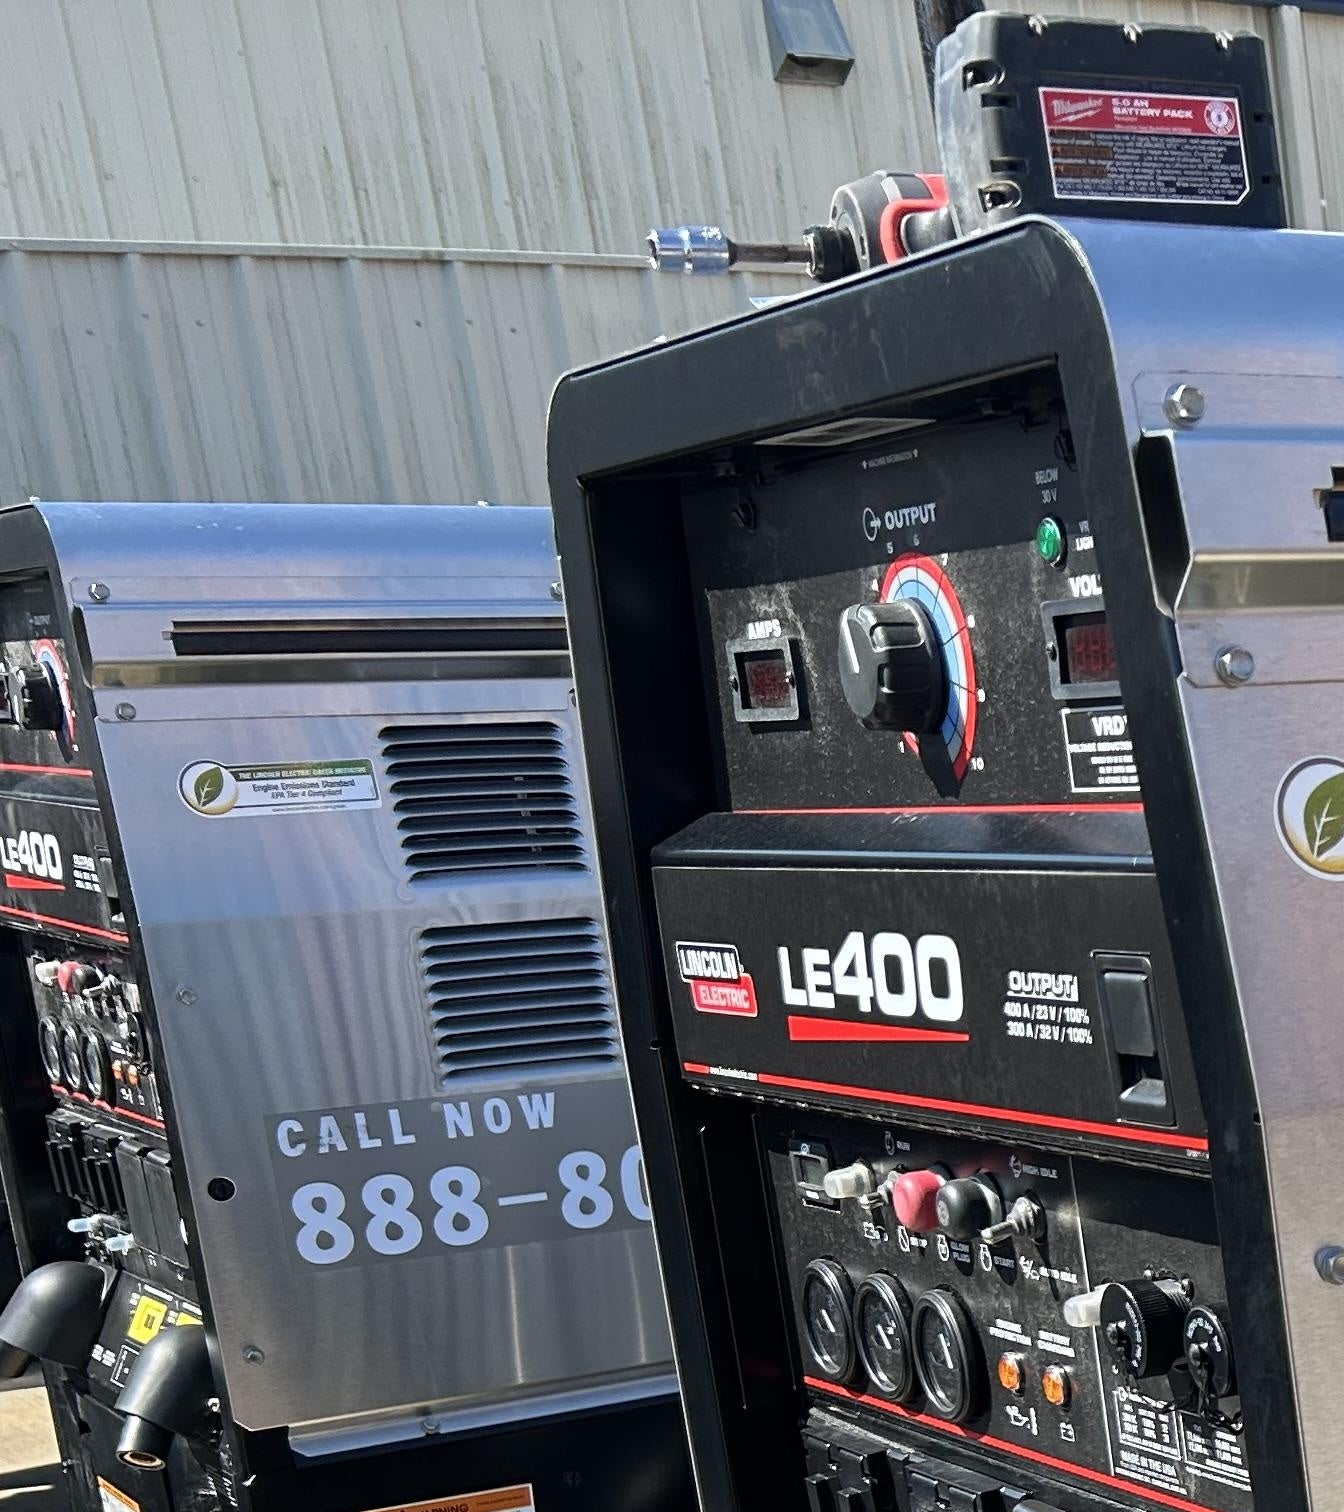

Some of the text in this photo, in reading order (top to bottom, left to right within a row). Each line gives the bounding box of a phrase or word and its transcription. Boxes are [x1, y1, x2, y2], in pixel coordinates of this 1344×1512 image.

[1113, 106, 1193, 119] BATTERY PACK
[1035, 468, 1058, 484] BELOW
[885, 503, 936, 530] OUTPUT
[887, 542, 893, 554] 5
[913, 534, 920, 546] 6
[1075, 536, 1094, 551] LIGH
[941, 553, 948, 566] 7
[1068, 574, 1102, 598] VOL
[748, 619, 782, 640] AMPS
[971, 757, 984, 770] 10
[680, 950, 738, 980] LINCOLN
[777, 931, 964, 1022] LE400
[1008, 971, 1072, 996] OUTPUT
[699, 985, 750, 1009] ELECTRIC
[1004, 1002, 1021, 1017] 400
[1063, 1007, 1089, 1024] 100%
[1007, 1021, 1024, 1036] 300
[1067, 1028, 1092, 1044] 100%
[276, 1092, 556, 1158] CALL NOW
